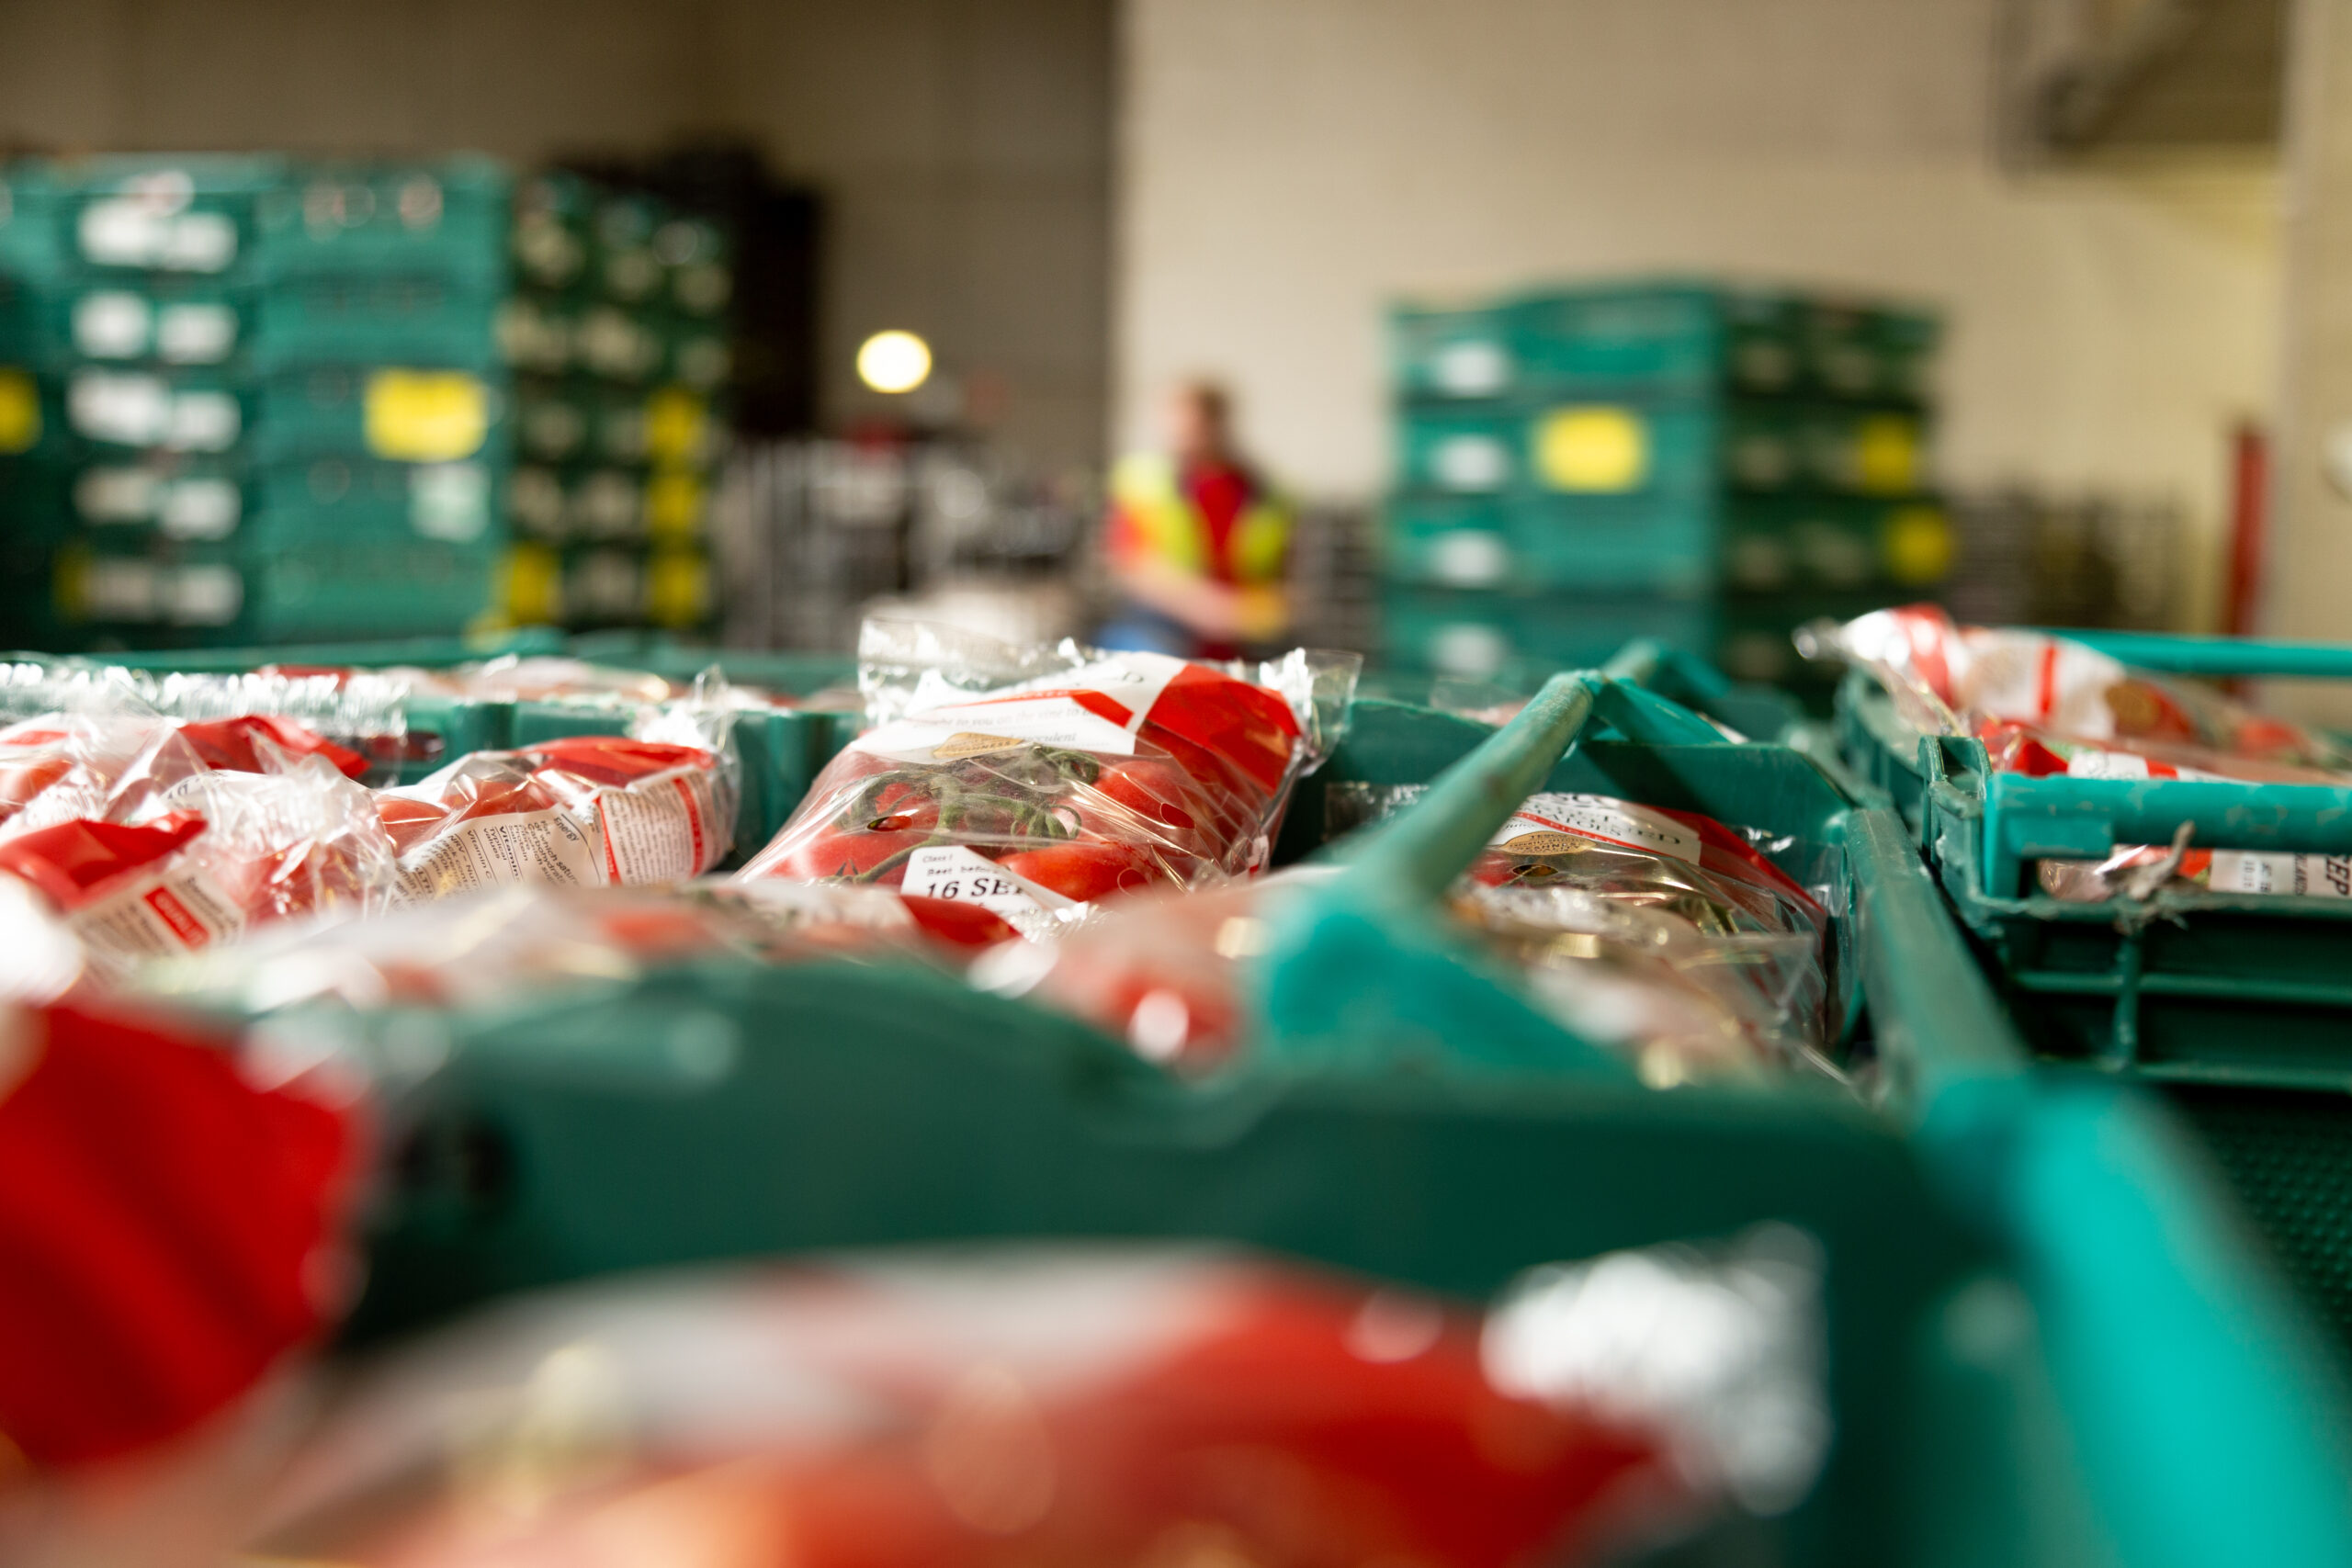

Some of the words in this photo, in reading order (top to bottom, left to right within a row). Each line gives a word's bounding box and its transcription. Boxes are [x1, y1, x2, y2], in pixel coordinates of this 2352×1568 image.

[482, 828, 501, 860] values
[554, 816, 580, 841] Energy
[467, 829, 488, 869] Vitamin
[484, 870, 492, 880] C
[490, 829, 507, 861] Typical
[927, 881, 960, 899] 16
